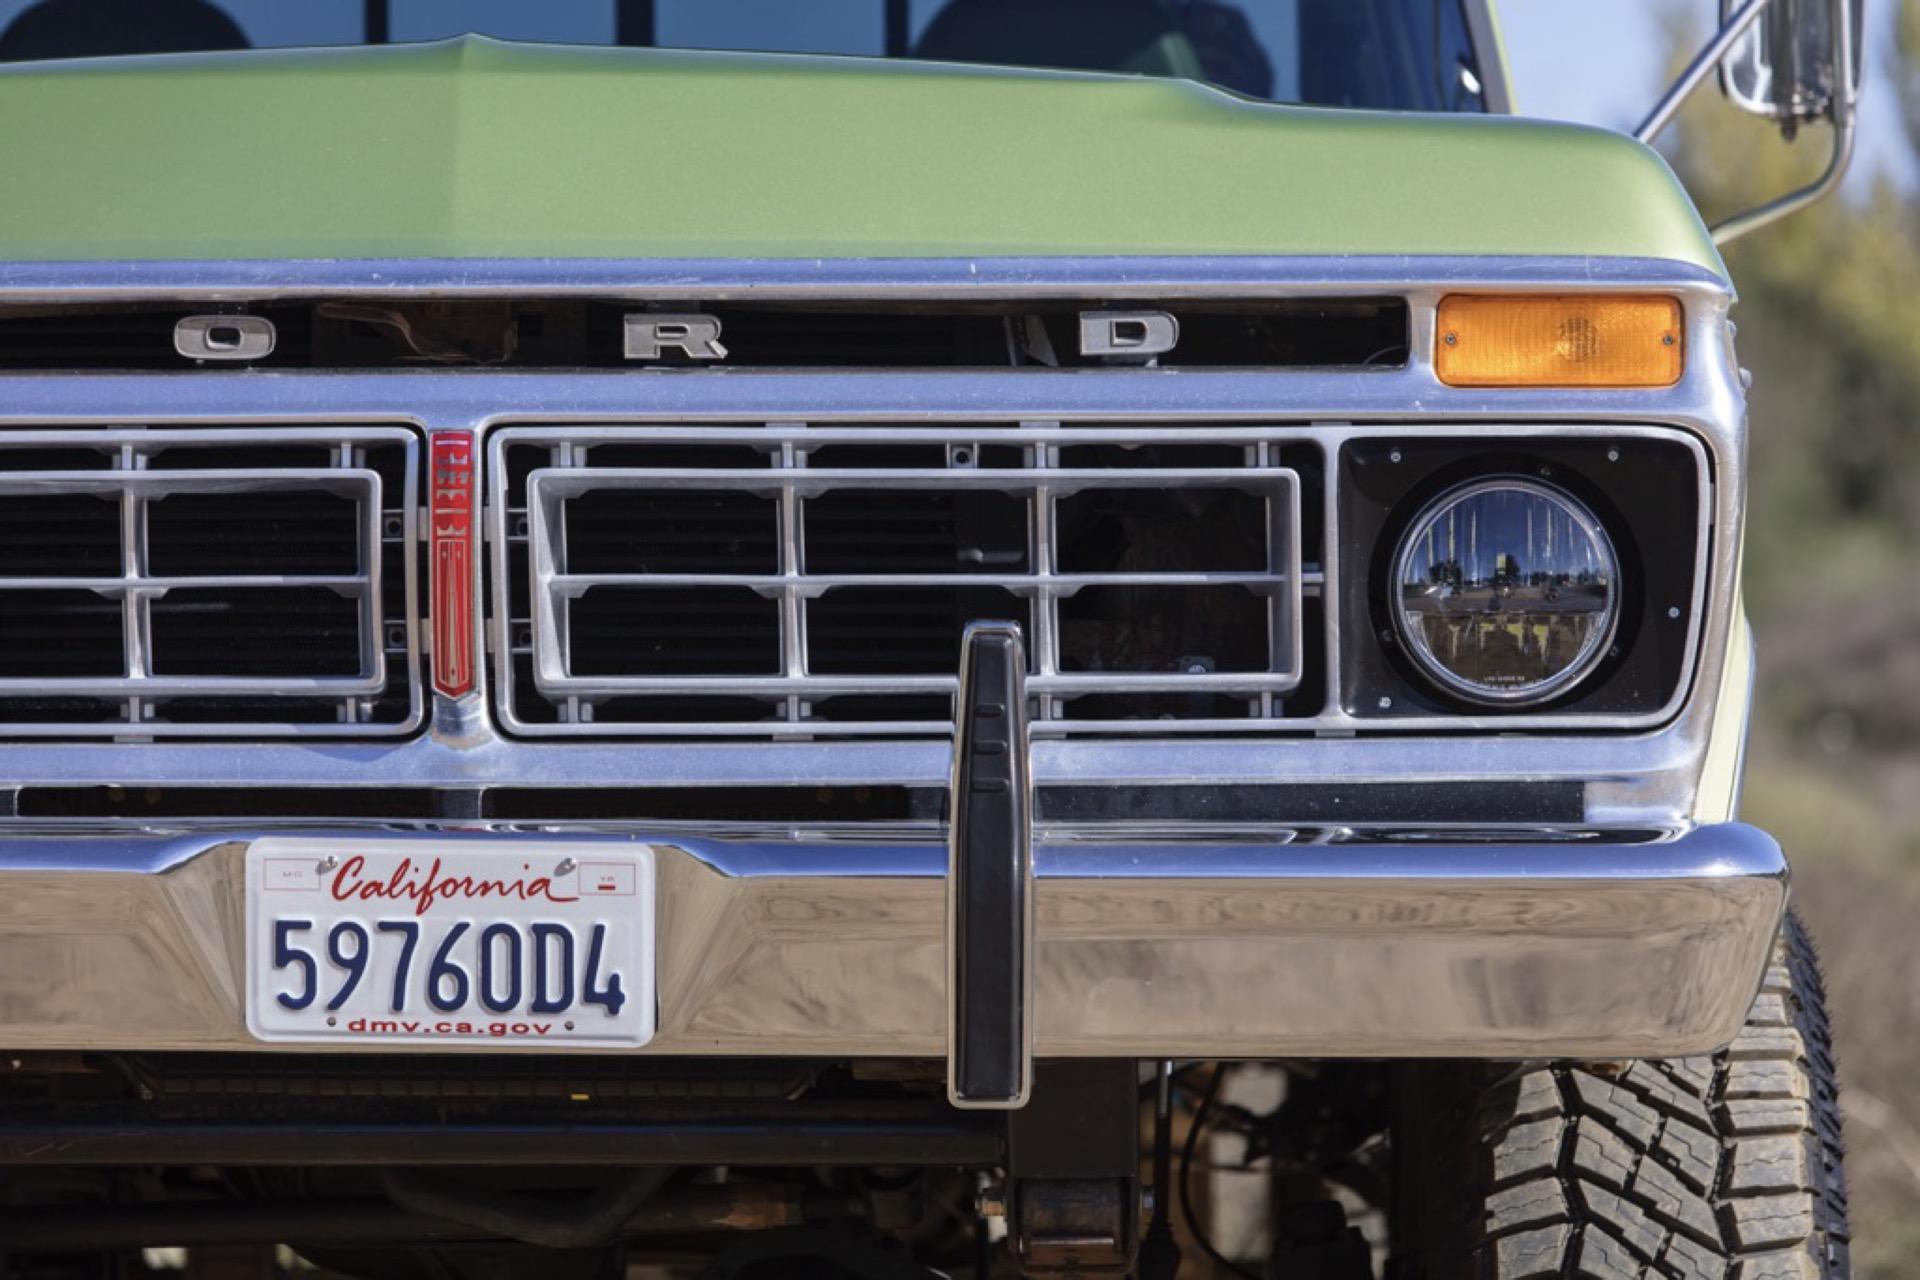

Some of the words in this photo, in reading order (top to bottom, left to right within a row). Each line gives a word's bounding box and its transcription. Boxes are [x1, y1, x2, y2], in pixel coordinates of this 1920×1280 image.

[332, 855, 578, 916] California
[272, 919, 626, 1016] 59760D4
[348, 1017, 552, 1037] dmv.ca.gov
